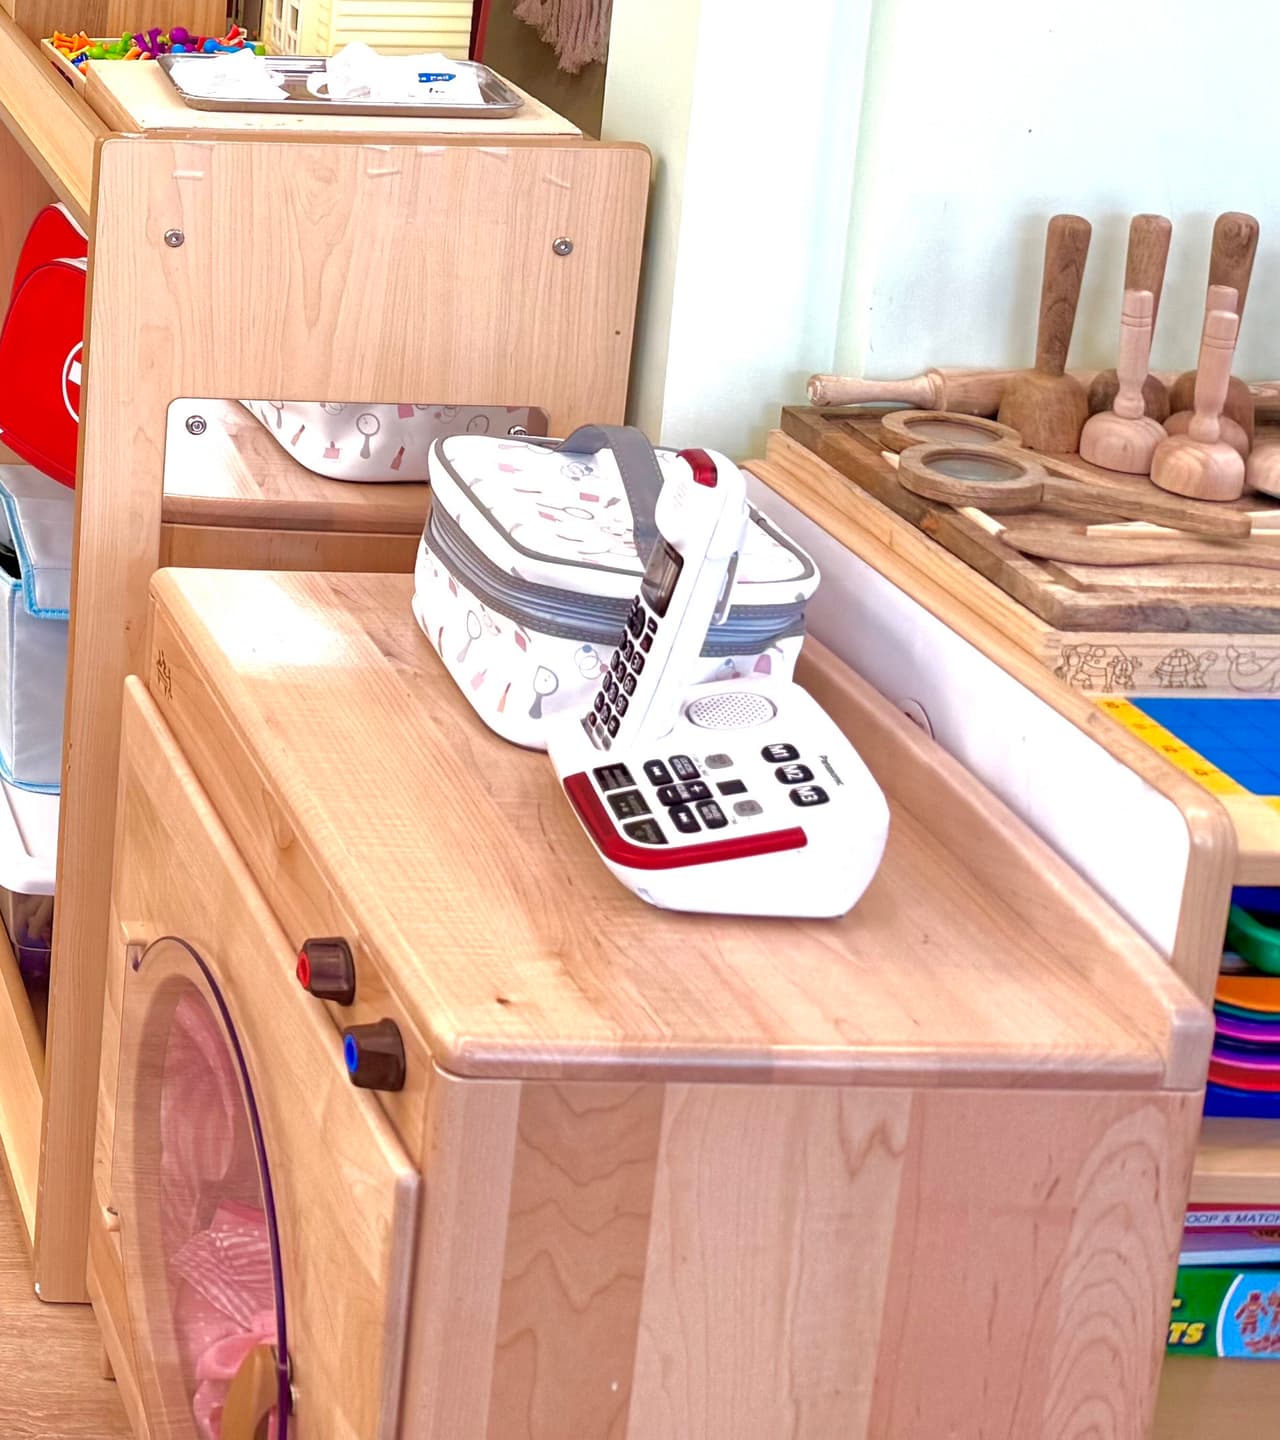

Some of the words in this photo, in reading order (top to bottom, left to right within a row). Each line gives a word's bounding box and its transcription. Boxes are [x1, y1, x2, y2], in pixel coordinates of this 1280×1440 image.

[767, 744, 790, 759] M1
[782, 764, 804, 781] M2
[795, 786, 819, 802] M3
[1186, 1214, 1218, 1224] OOP
